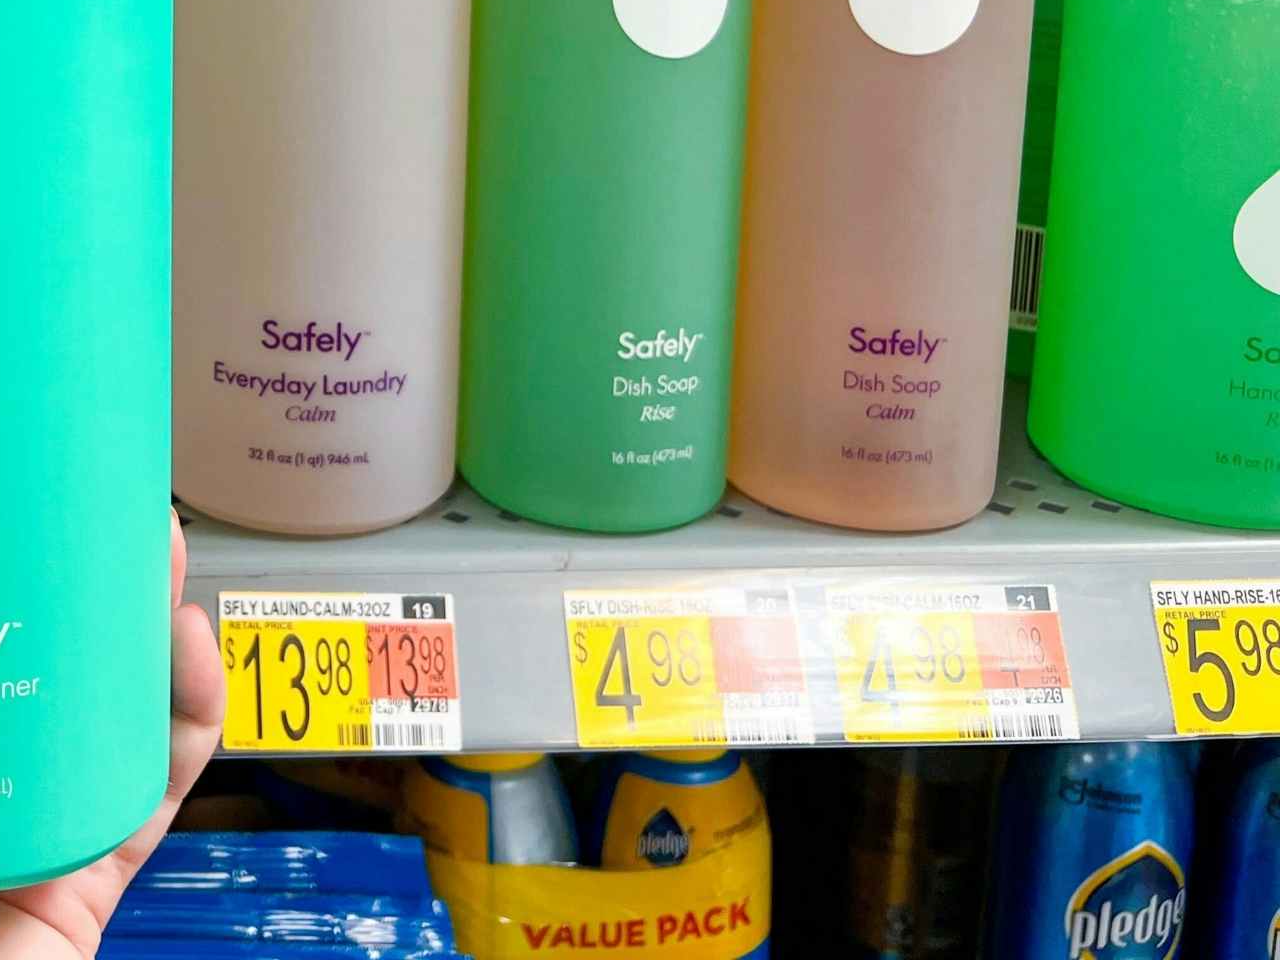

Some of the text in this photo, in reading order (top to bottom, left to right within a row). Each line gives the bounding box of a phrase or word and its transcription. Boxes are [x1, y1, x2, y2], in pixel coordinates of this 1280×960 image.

[261, 318, 363, 362] Safely
[617, 327, 698, 363] Safely
[847, 326, 940, 364] Safely
[213, 359, 408, 402] Everyday Laundry
[612, 373, 699, 397] Dish Soap
[843, 369, 942, 398] Dish Soap
[284, 404, 337, 423] Calm
[639, 403, 676, 422] Rise
[865, 402, 916, 421] Calm
[248, 447, 263, 460] 32
[570, 599, 602, 615] SFLY
[1015, 594, 1037, 610] 21
[1156, 591, 1191, 606] SFLY
[223, 600, 391, 617] SFLY LAUND-CALM-32OZ
[411, 602, 434, 618] 19
[1199, 610, 1227, 619] PRICE
[413, 696, 447, 713] 2978
[522, 897, 752, 950] VALUE PACK
[1069, 887, 1186, 960] pledge
